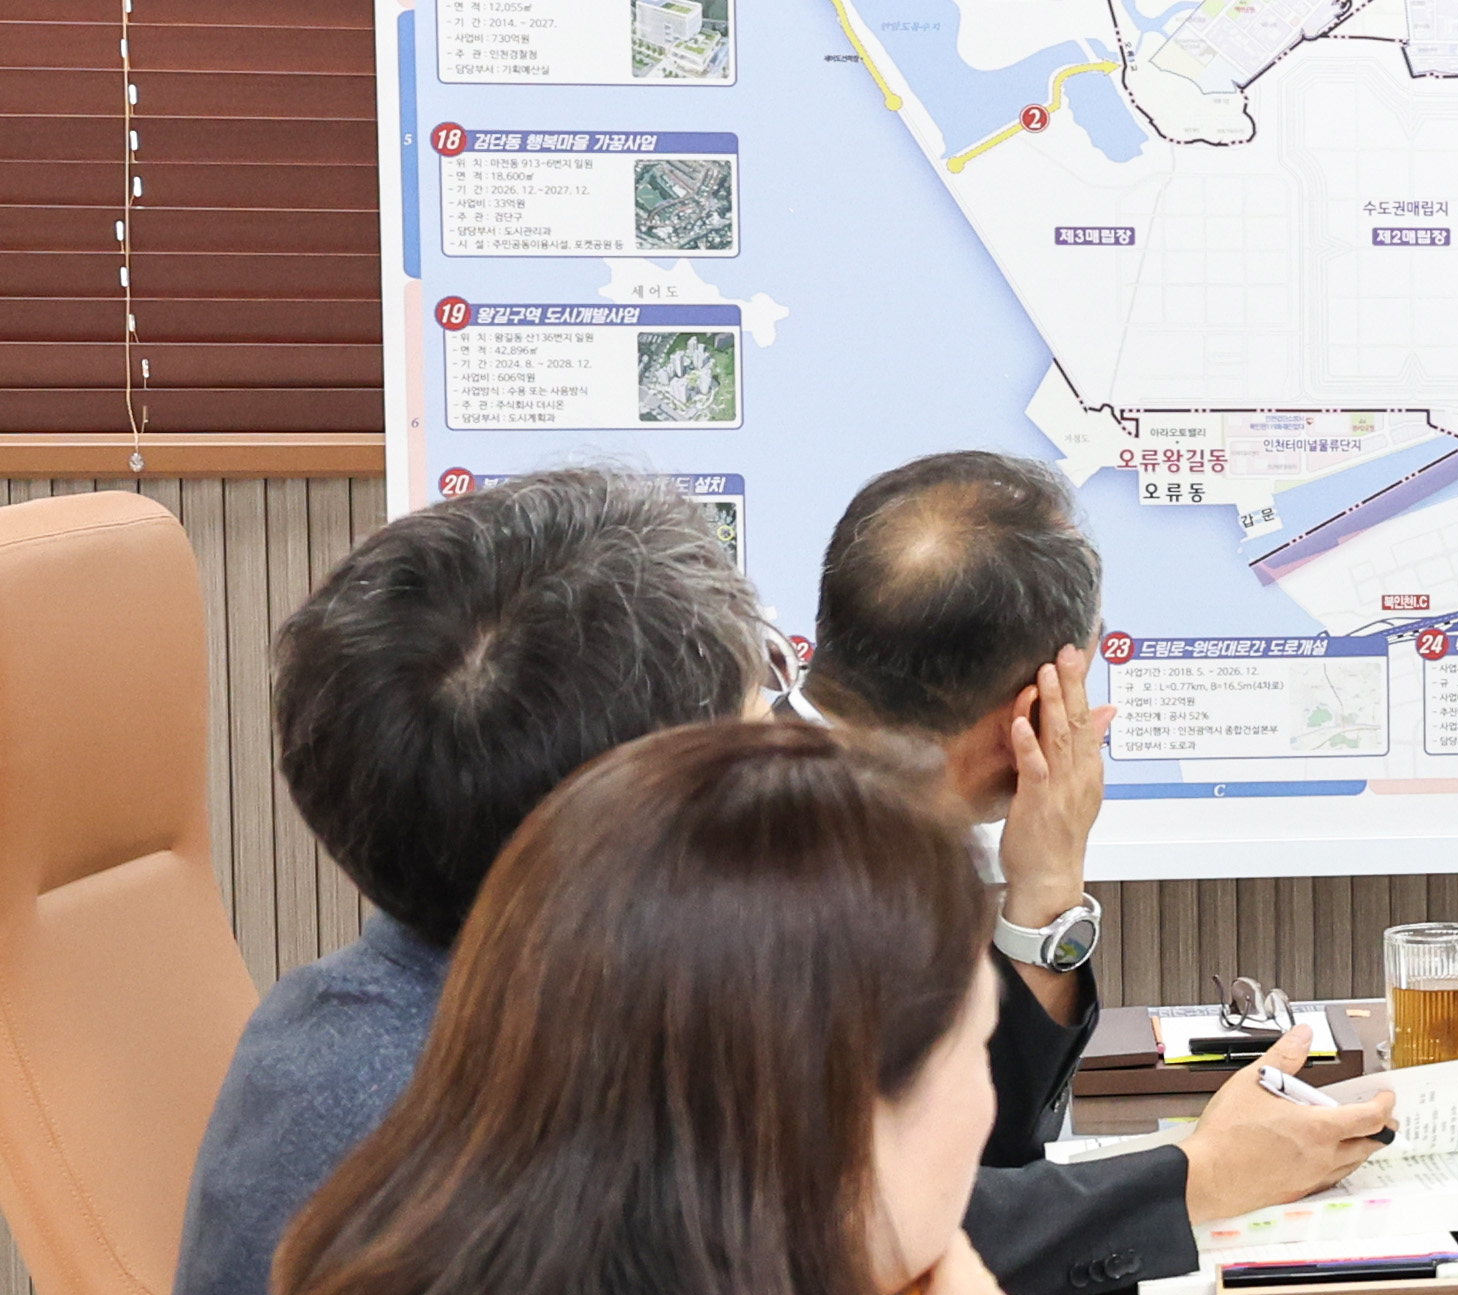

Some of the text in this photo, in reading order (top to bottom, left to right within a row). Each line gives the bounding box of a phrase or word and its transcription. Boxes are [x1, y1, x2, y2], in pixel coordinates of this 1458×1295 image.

[438, 129, 461, 150] 18
[474, 133, 657, 152] 검단동 행복마을 가꿈사업
[1363, 200, 1449, 216] 수도권매립지
[1060, 229, 1132, 244] 제3매립장
[1376, 229, 1447, 245] 제2매립장
[631, 285, 679, 299] 세어도
[442, 303, 466, 323] 19
[477, 306, 640, 325] 왕길구역 도시개발사업
[1263, 437, 1362, 452] 인천터미널물류단지
[1116, 449, 1228, 473] 오류왕길동
[442, 474, 469, 494] 20
[695, 477, 726, 494] 설치
[1143, 483, 1206, 503] 오류동
[1241, 508, 1274, 528] 갑문
[1105, 638, 1129, 658] 23
[1140, 639, 1328, 657] 드림로~원당대로간 도로개설
[1419, 635, 1444, 654] 24
